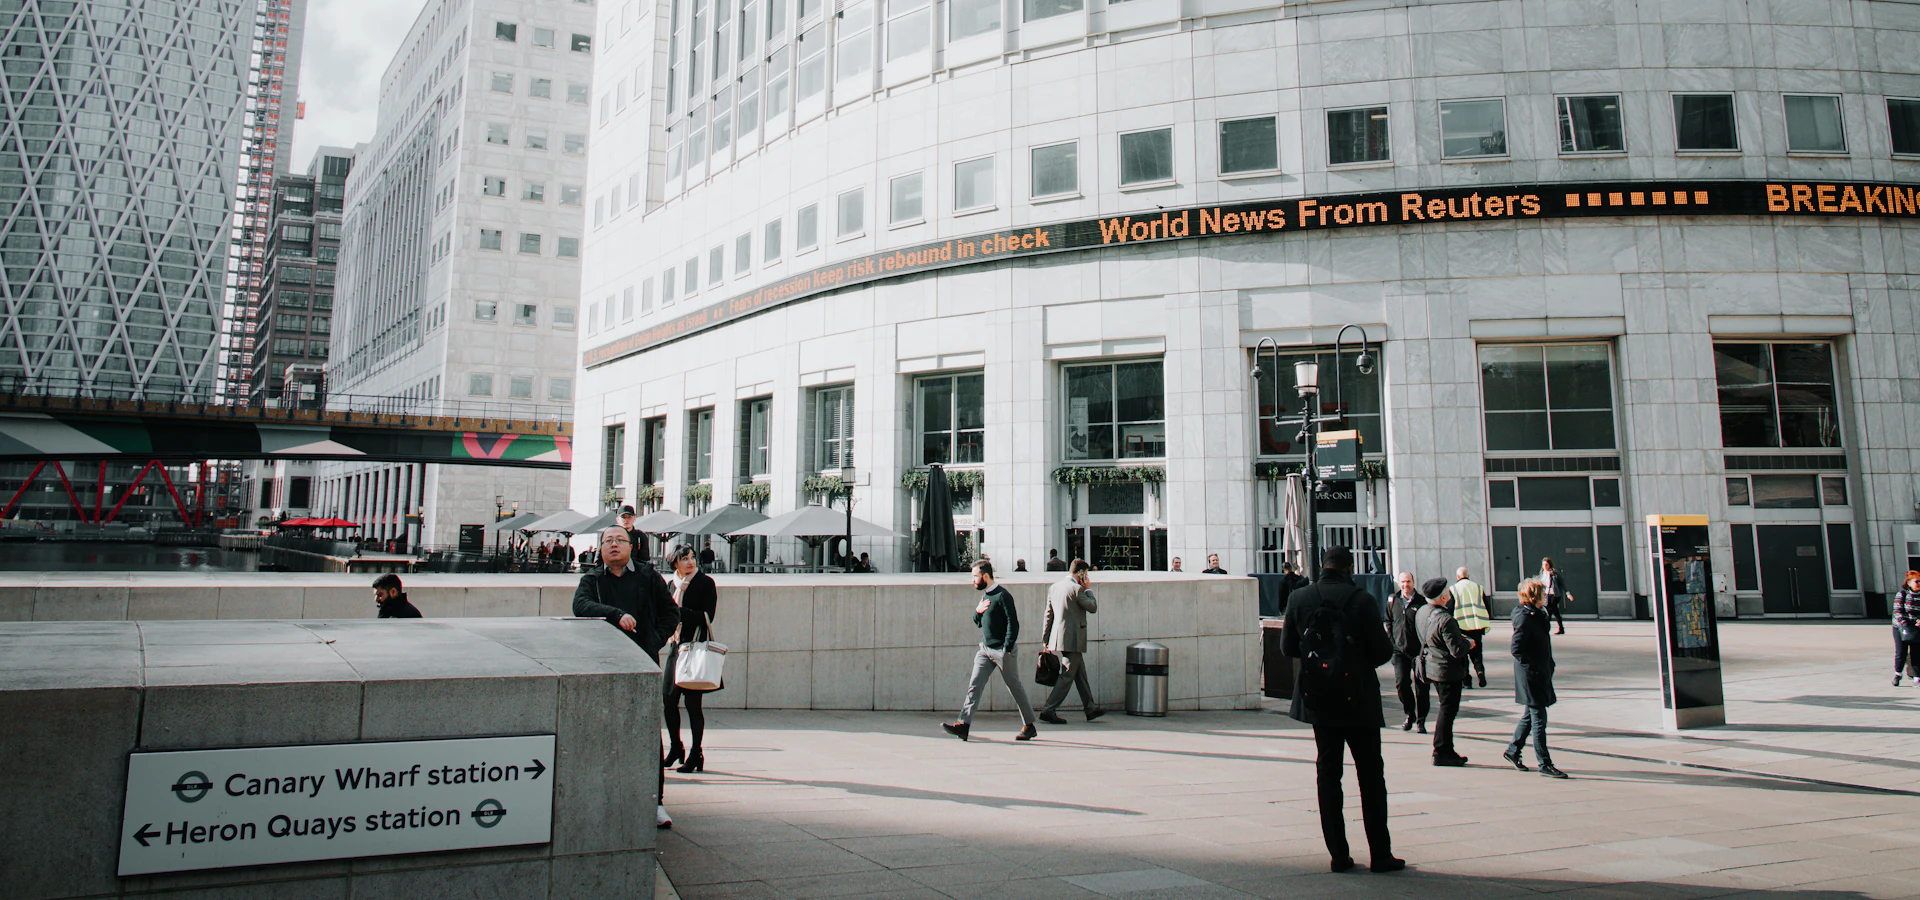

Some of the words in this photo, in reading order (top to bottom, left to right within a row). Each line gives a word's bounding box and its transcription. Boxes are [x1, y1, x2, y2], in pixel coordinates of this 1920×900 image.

[1098, 210, 1190, 245] World
[1199, 207, 1286, 235] News
[1298, 199, 1389, 228] From
[1400, 191, 1541, 221] Reuters
[1766, 184, 1920, 215] BREAKIN
[730, 296, 752, 315] Fears
[754, 290, 764, 306] of
[764, 276, 811, 303] recession
[813, 267, 844, 287] keep
[847, 258, 875, 280] risk
[879, 241, 952, 273] rebound
[957, 239, 975, 259] in
[981, 227, 1050, 255] check
[1103, 545, 1131, 558] BAR
[225, 773, 326, 798] Canary
[334, 764, 421, 791] Wharf
[427, 761, 519, 786] station
[165, 820, 257, 846] Heron
[267, 814, 357, 840] Quays
[365, 805, 460, 832] station
